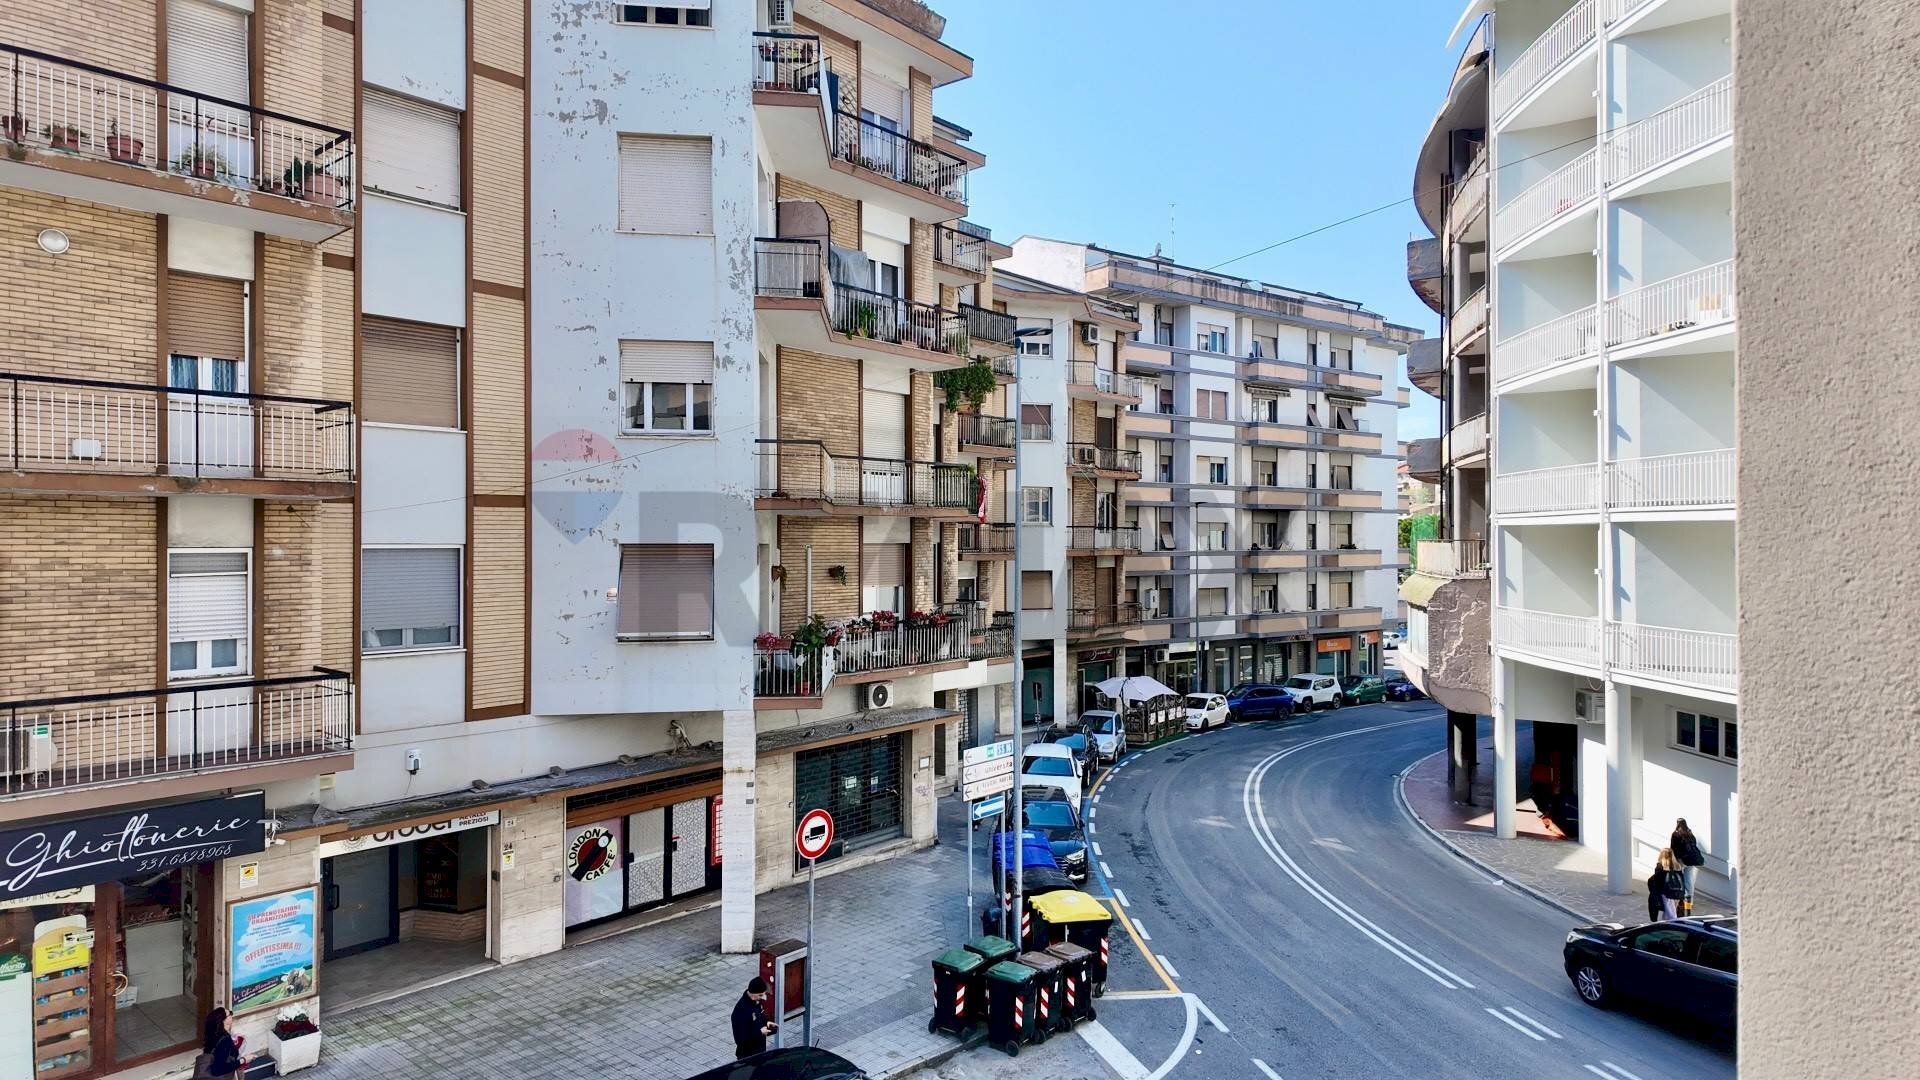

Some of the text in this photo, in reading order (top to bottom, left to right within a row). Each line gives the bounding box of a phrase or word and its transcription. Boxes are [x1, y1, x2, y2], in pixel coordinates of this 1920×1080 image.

[459, 816, 489, 827] PREZIOSI
[6, 813, 250, 892] Ghiottonerie
[136, 843, 232, 872] 331.6828968
[569, 828, 601, 868] LONDON
[245, 942, 293, 962] OFFERTISSIMA
